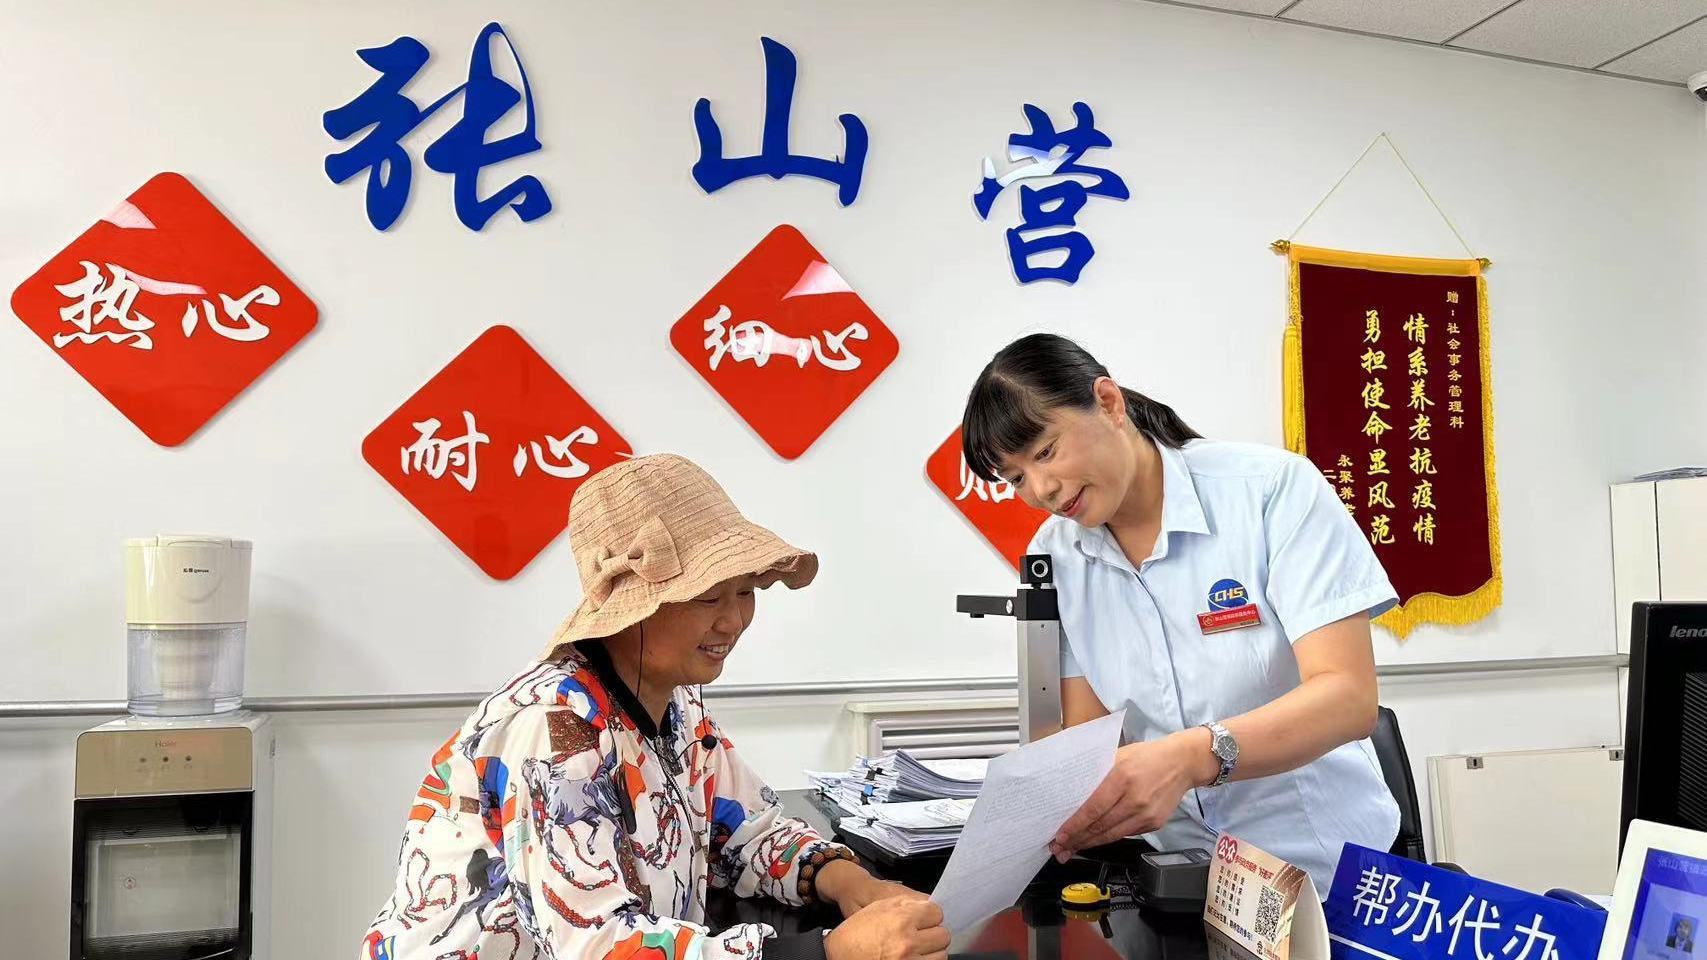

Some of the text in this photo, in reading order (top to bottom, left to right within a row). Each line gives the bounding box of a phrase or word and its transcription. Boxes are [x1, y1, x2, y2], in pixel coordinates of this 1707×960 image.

[322, 21, 1131, 286] 张山营
[52, 260, 281, 350] 热心
[703, 304, 870, 372] 细心
[400, 410, 600, 493] 耐心
[1360, 311, 1395, 545] 勇担使命显风范
[1403, 313, 1438, 545] 情系养老抗疫情
[1353, 866, 1560, 960] 帮办代办
